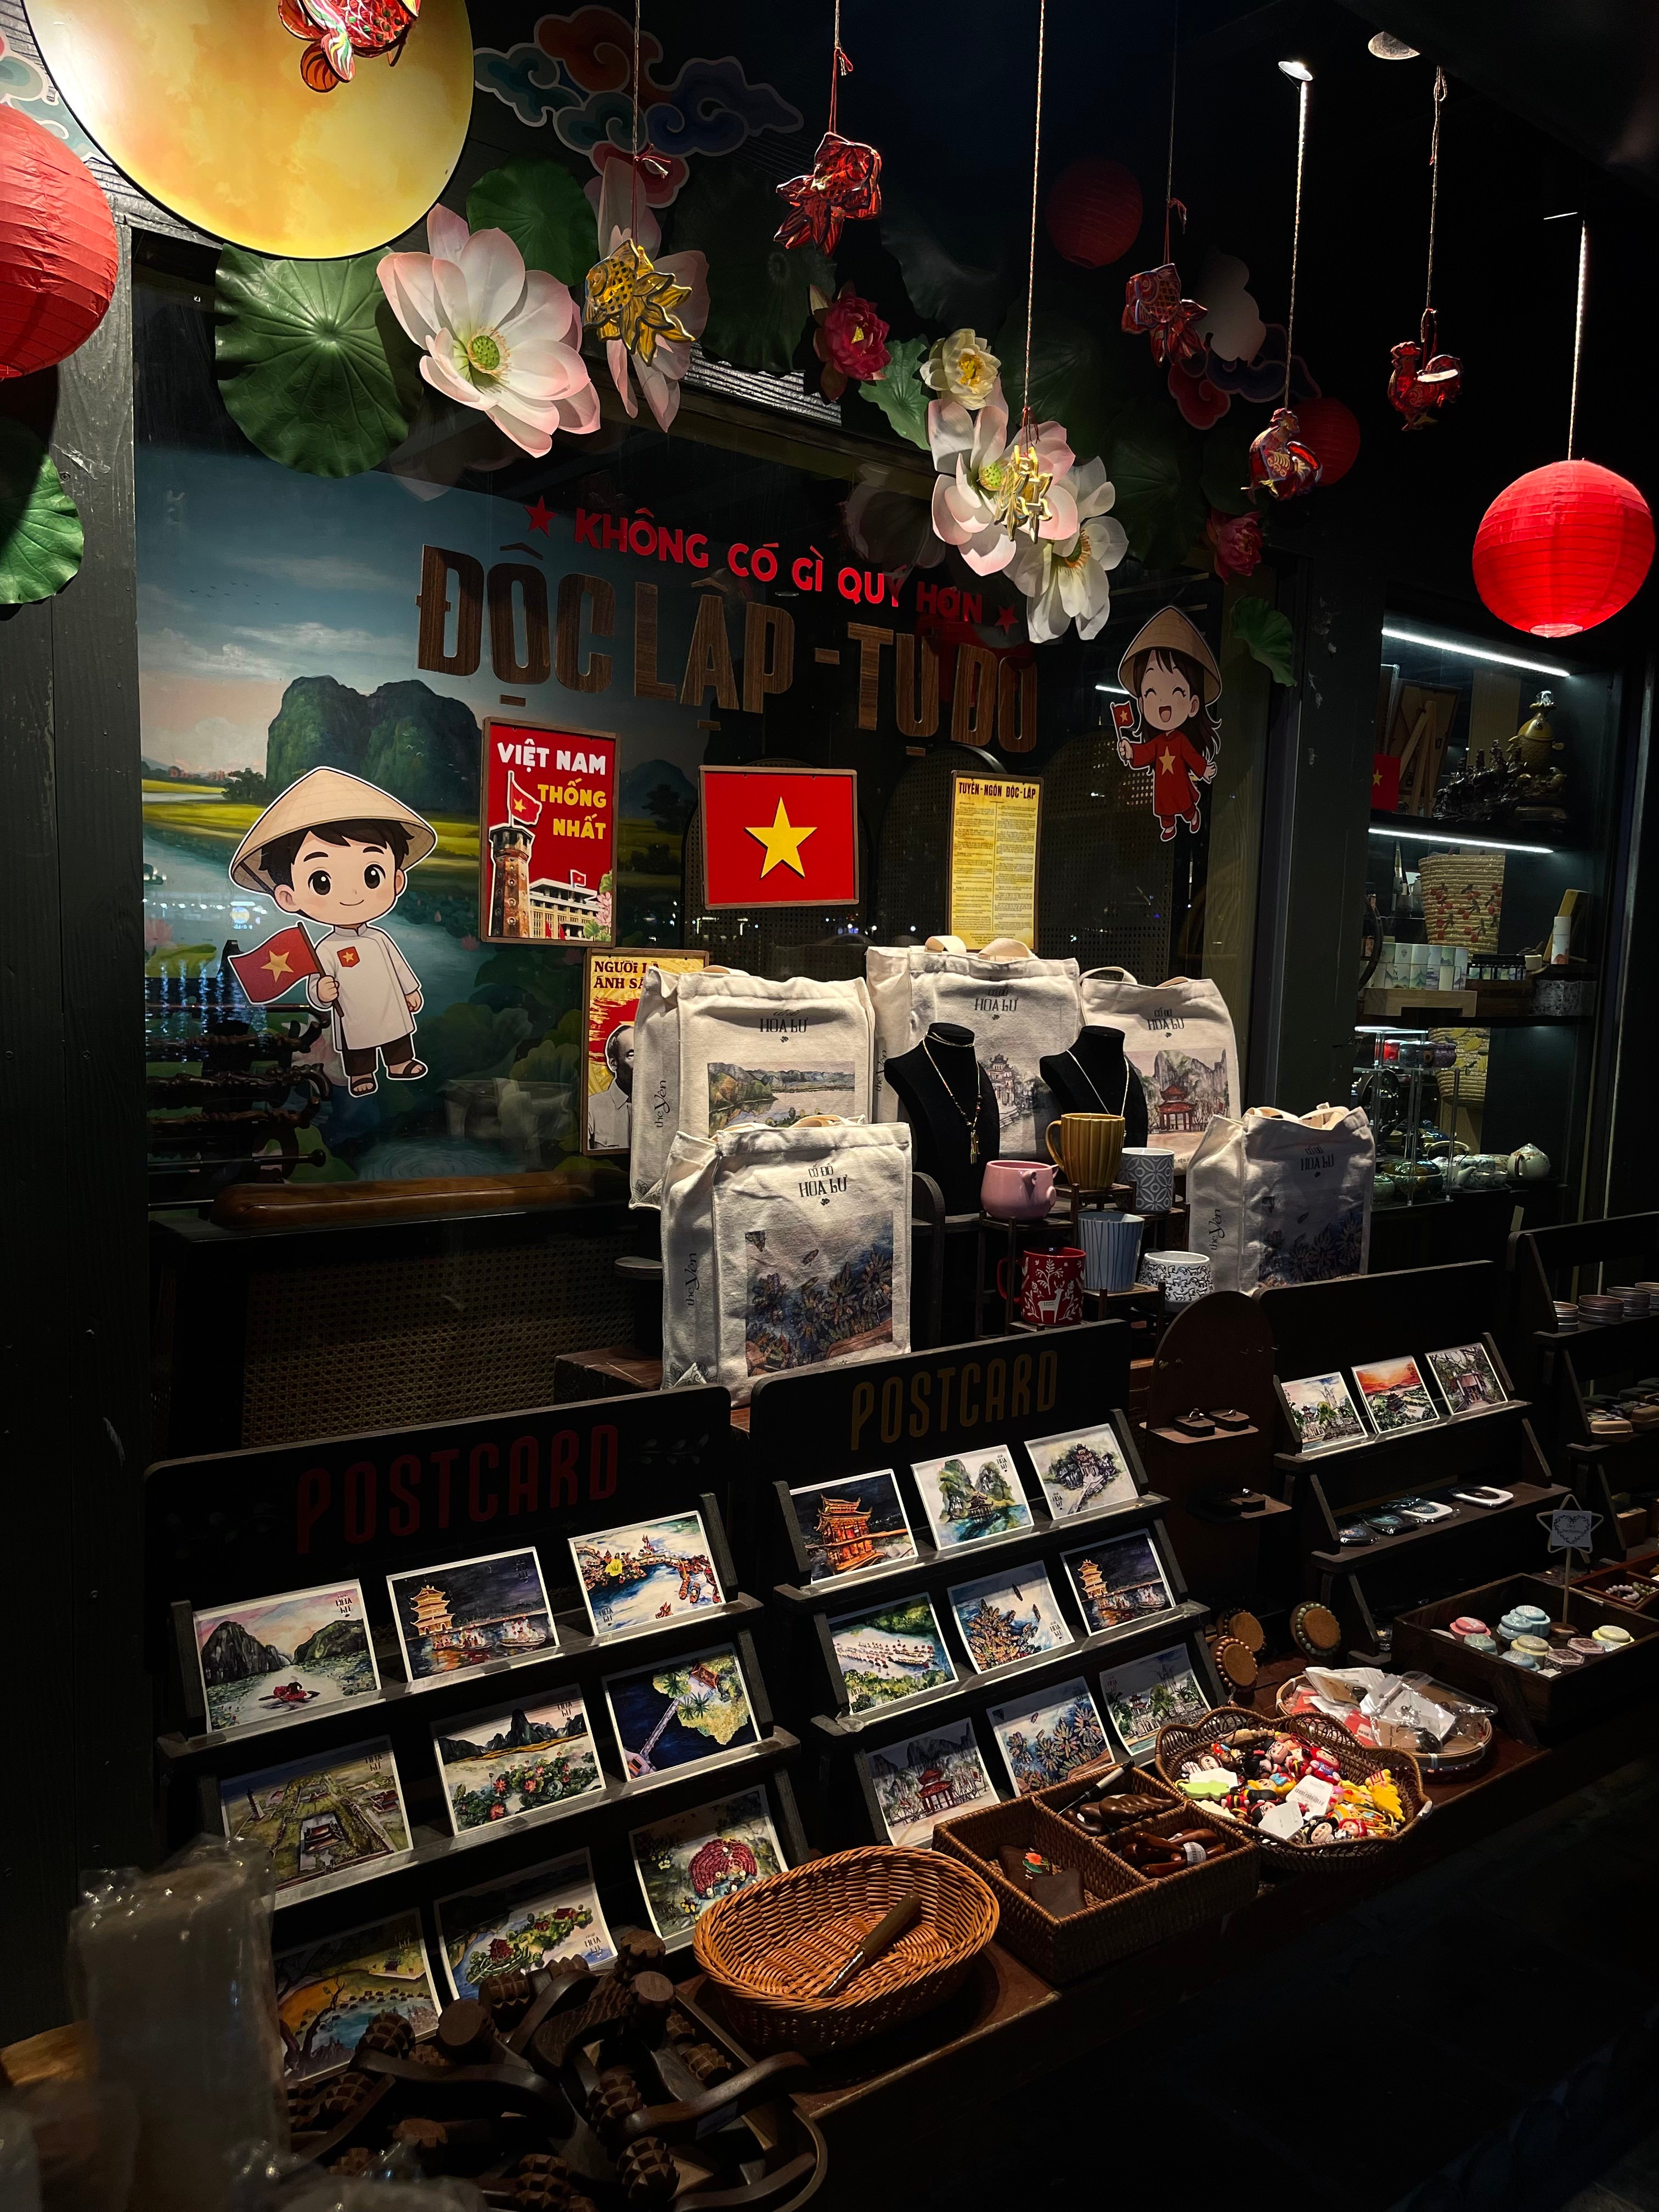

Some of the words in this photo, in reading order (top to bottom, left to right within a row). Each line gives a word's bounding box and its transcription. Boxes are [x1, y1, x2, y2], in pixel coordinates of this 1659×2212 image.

[574, 507, 708, 568] KHÔNG
[728, 543, 778, 582] CÓ
[792, 545, 823, 591] GÌ
[415, 542, 616, 707] ĐỘC
[634, 577, 795, 731] LẬP
[950, 642, 1038, 754] DO
[496, 738, 550, 773] VIỆT
[556, 750, 606, 775] NAM
[537, 778, 607, 809] THỐNG
[553, 813, 606, 840] NHẤT
[593, 975, 625, 989] ÁNH
[759, 1018, 787, 1033] HOA
[799, 1180, 827, 1198] HOA
[850, 1350, 1058, 1451] POSTCARD
[295, 1424, 619, 1555] POSTCARD
